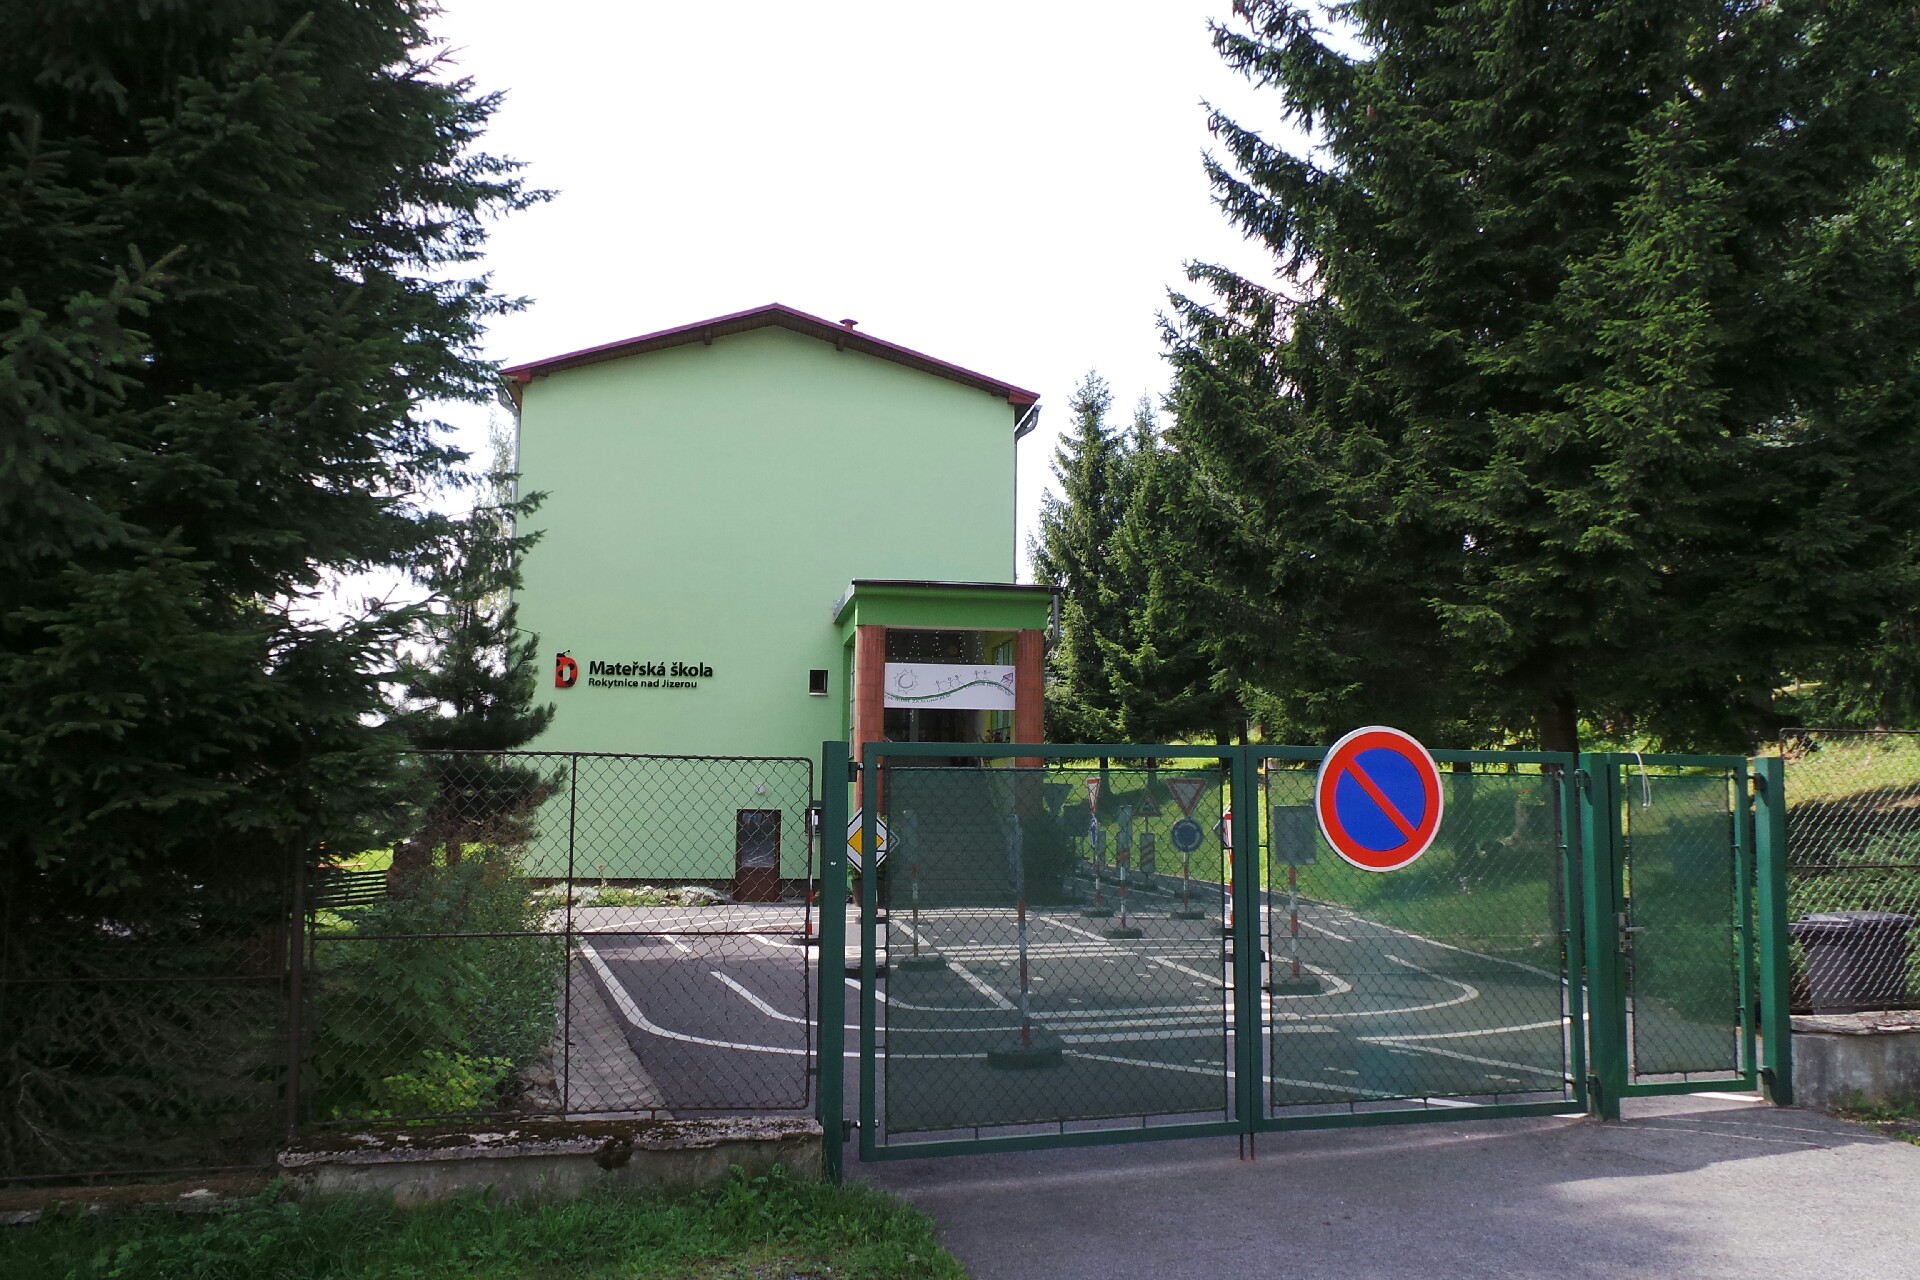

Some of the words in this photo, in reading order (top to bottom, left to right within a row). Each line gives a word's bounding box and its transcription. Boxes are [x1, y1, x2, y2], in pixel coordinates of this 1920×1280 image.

[589, 660, 666, 676] Mateřská
[670, 661, 713, 678] škola
[588, 678, 639, 689] Rokytnice
[640, 679, 660, 688] nad
[661, 680, 698, 688] Jizerou
